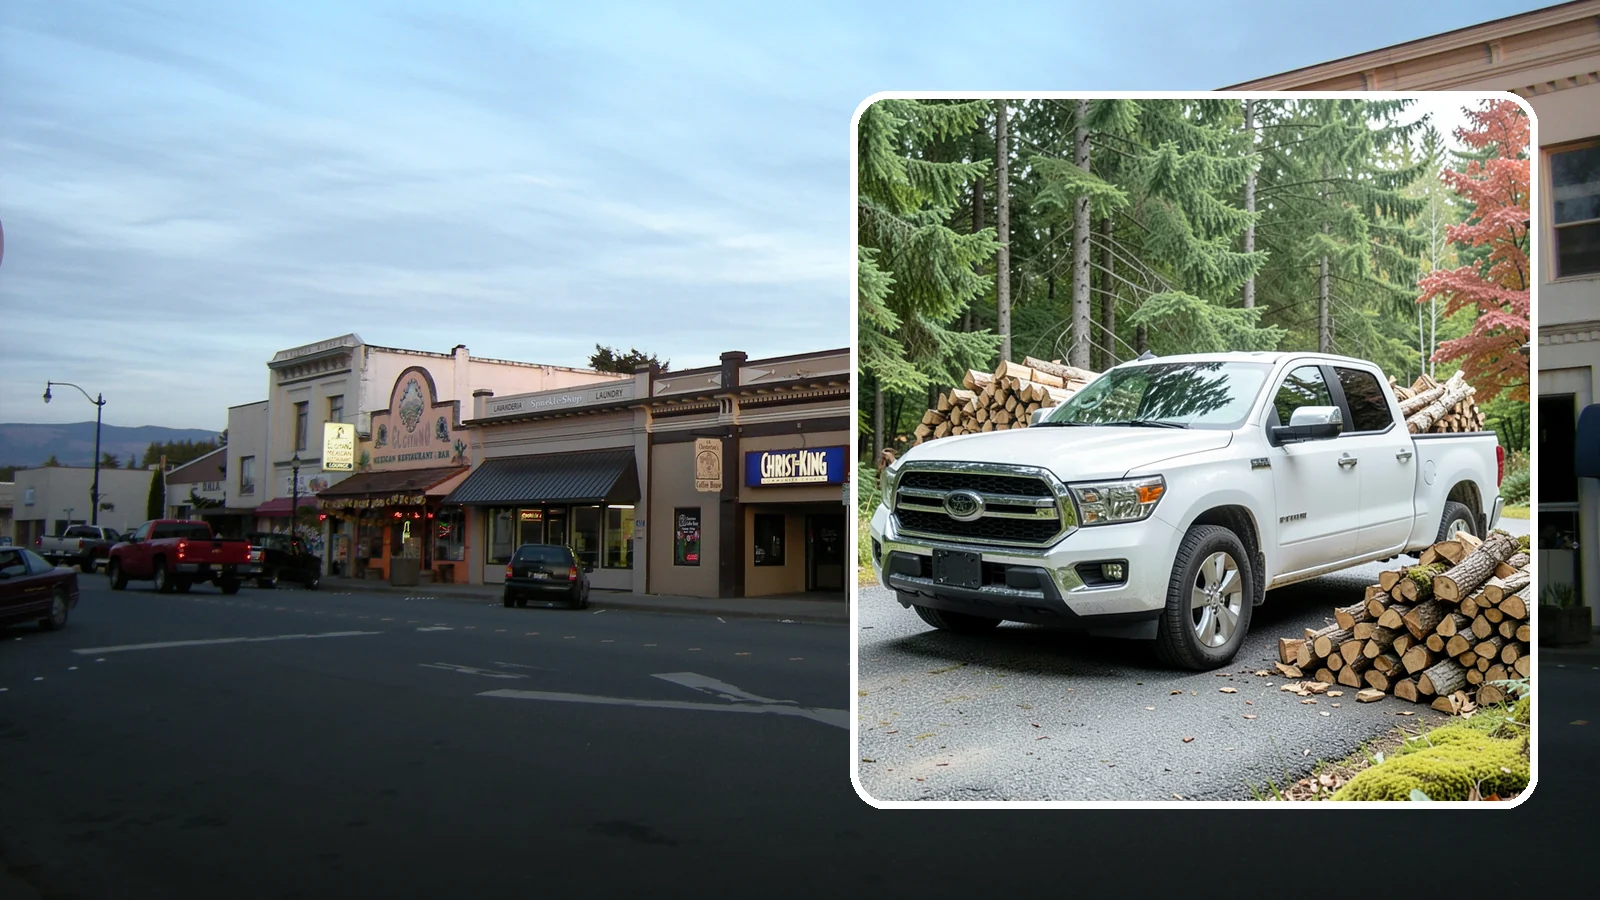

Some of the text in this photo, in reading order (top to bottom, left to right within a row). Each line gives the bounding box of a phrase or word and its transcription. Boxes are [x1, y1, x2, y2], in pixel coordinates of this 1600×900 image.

[595, 389, 624, 400] LAUNDRY
[493, 402, 523, 412] LAVANDERIA
[374, 450, 450, 464] MEXICAN RESTAURANT BAR
[761, 450, 827, 478] CHRIST KING
